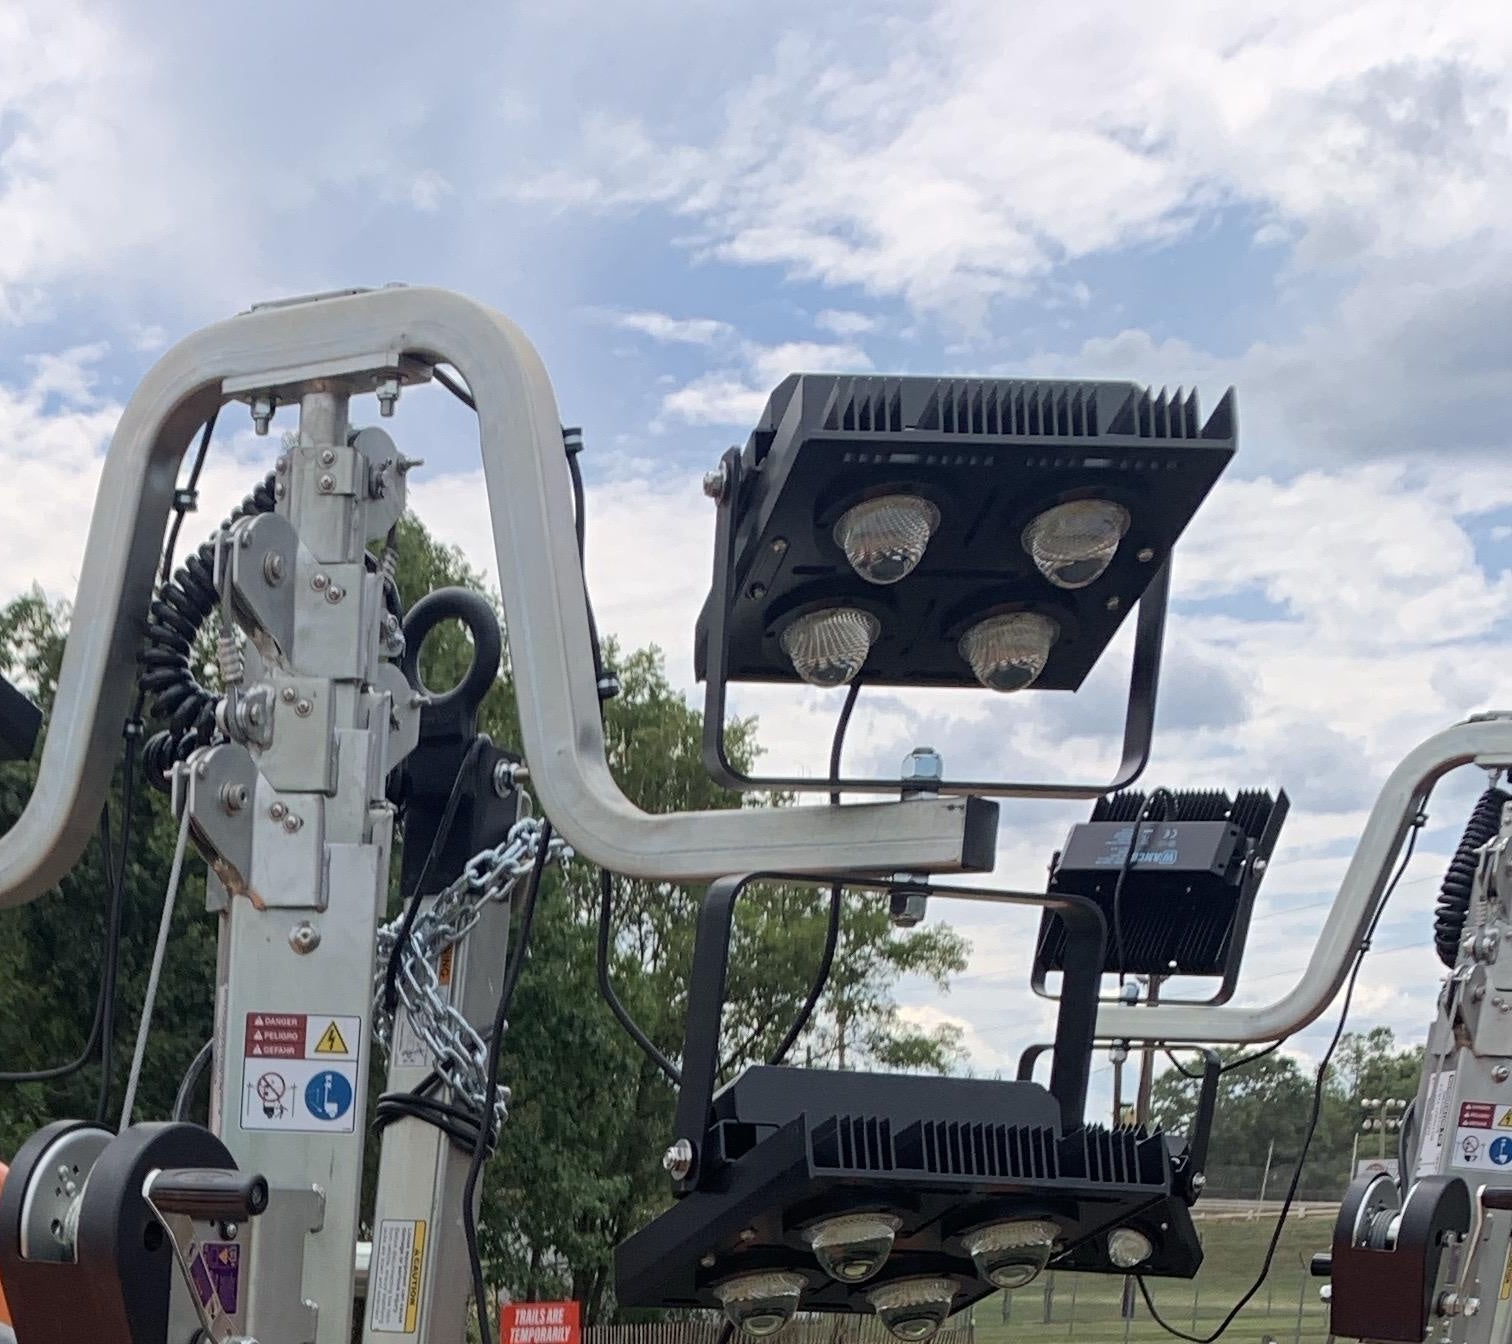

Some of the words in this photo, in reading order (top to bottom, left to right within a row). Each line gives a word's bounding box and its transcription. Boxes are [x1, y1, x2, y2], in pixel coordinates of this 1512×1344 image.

[264, 1017, 298, 1027] DANGER
[263, 1030, 298, 1041] PELIGRO
[263, 1044, 296, 1055] GEFAHR
[408, 1256, 420, 1306] CAUTION
[514, 1308, 546, 1325] TRAILS
[546, 1307, 565, 1325] ARE
[509, 1325, 572, 1344] TEMPORARILY
